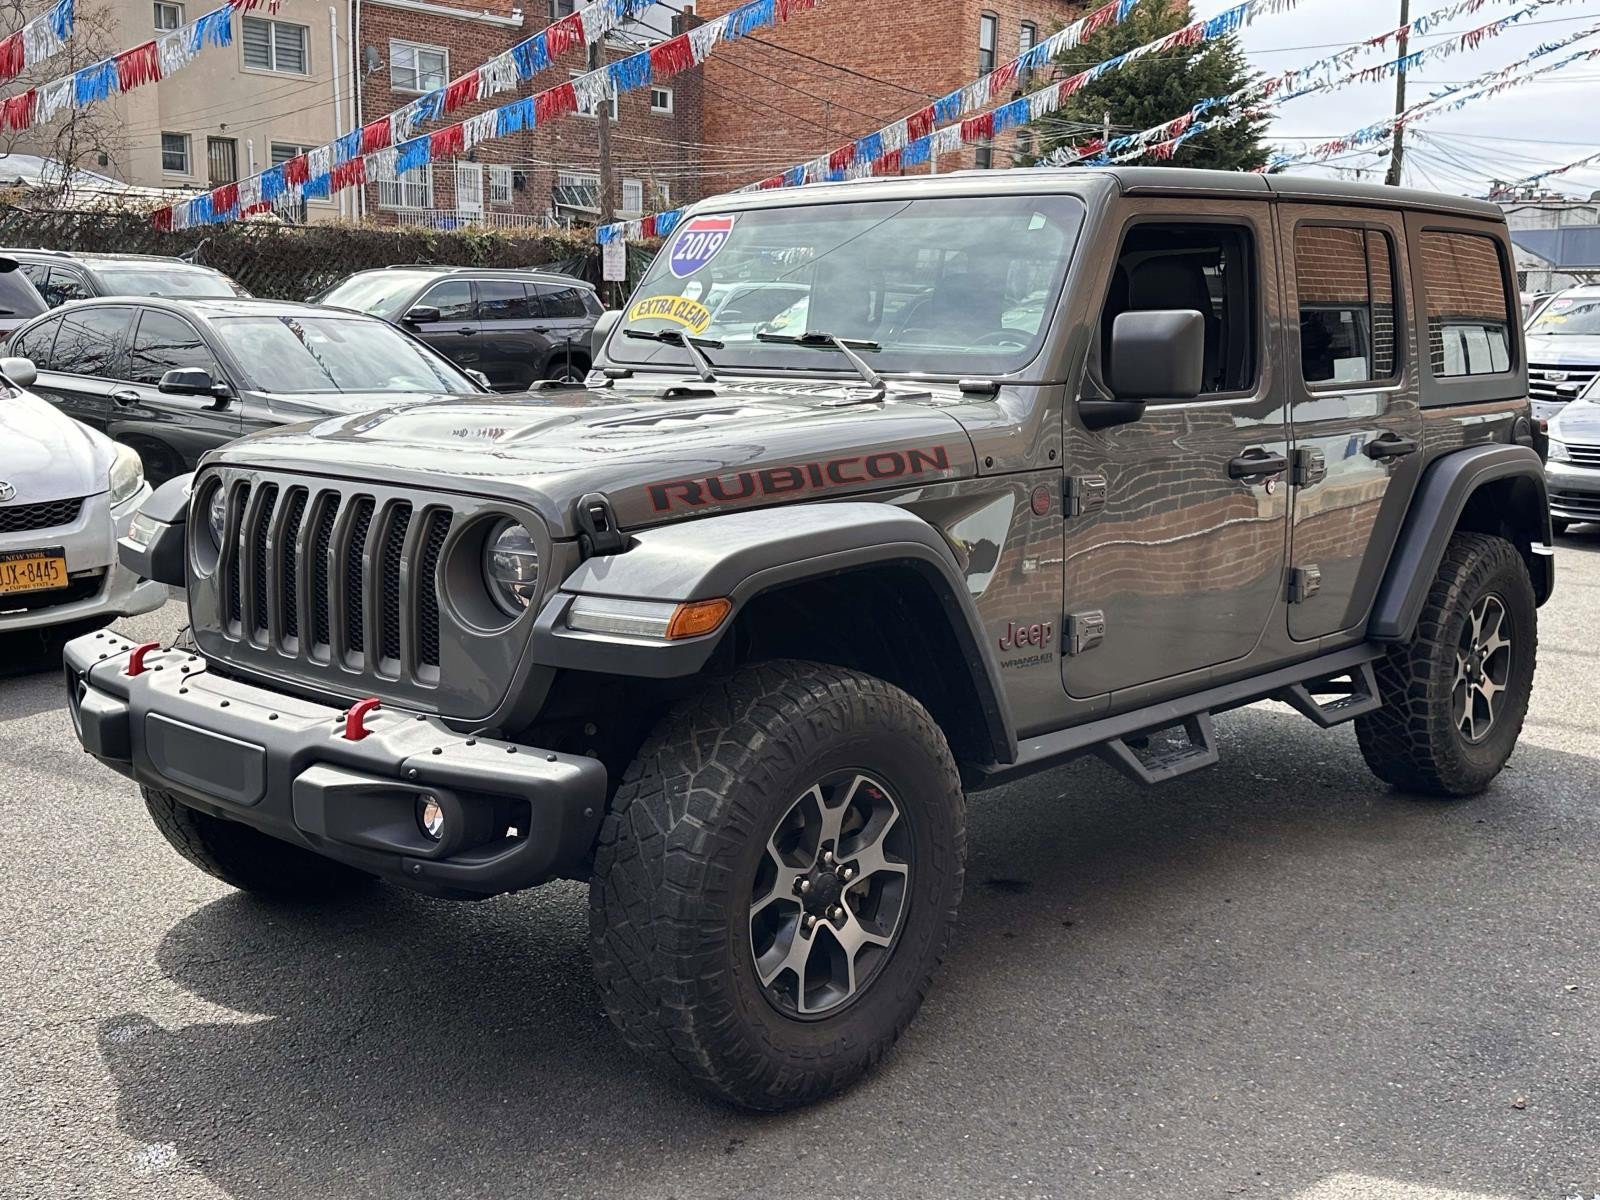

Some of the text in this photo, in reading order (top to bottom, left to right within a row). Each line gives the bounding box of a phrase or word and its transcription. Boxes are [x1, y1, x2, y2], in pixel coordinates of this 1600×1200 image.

[673, 232, 724, 260] 2019
[637, 299, 710, 329] EXTRA CLEAN
[647, 445, 950, 512] RUBICON
[999, 621, 1053, 651] Jeep
